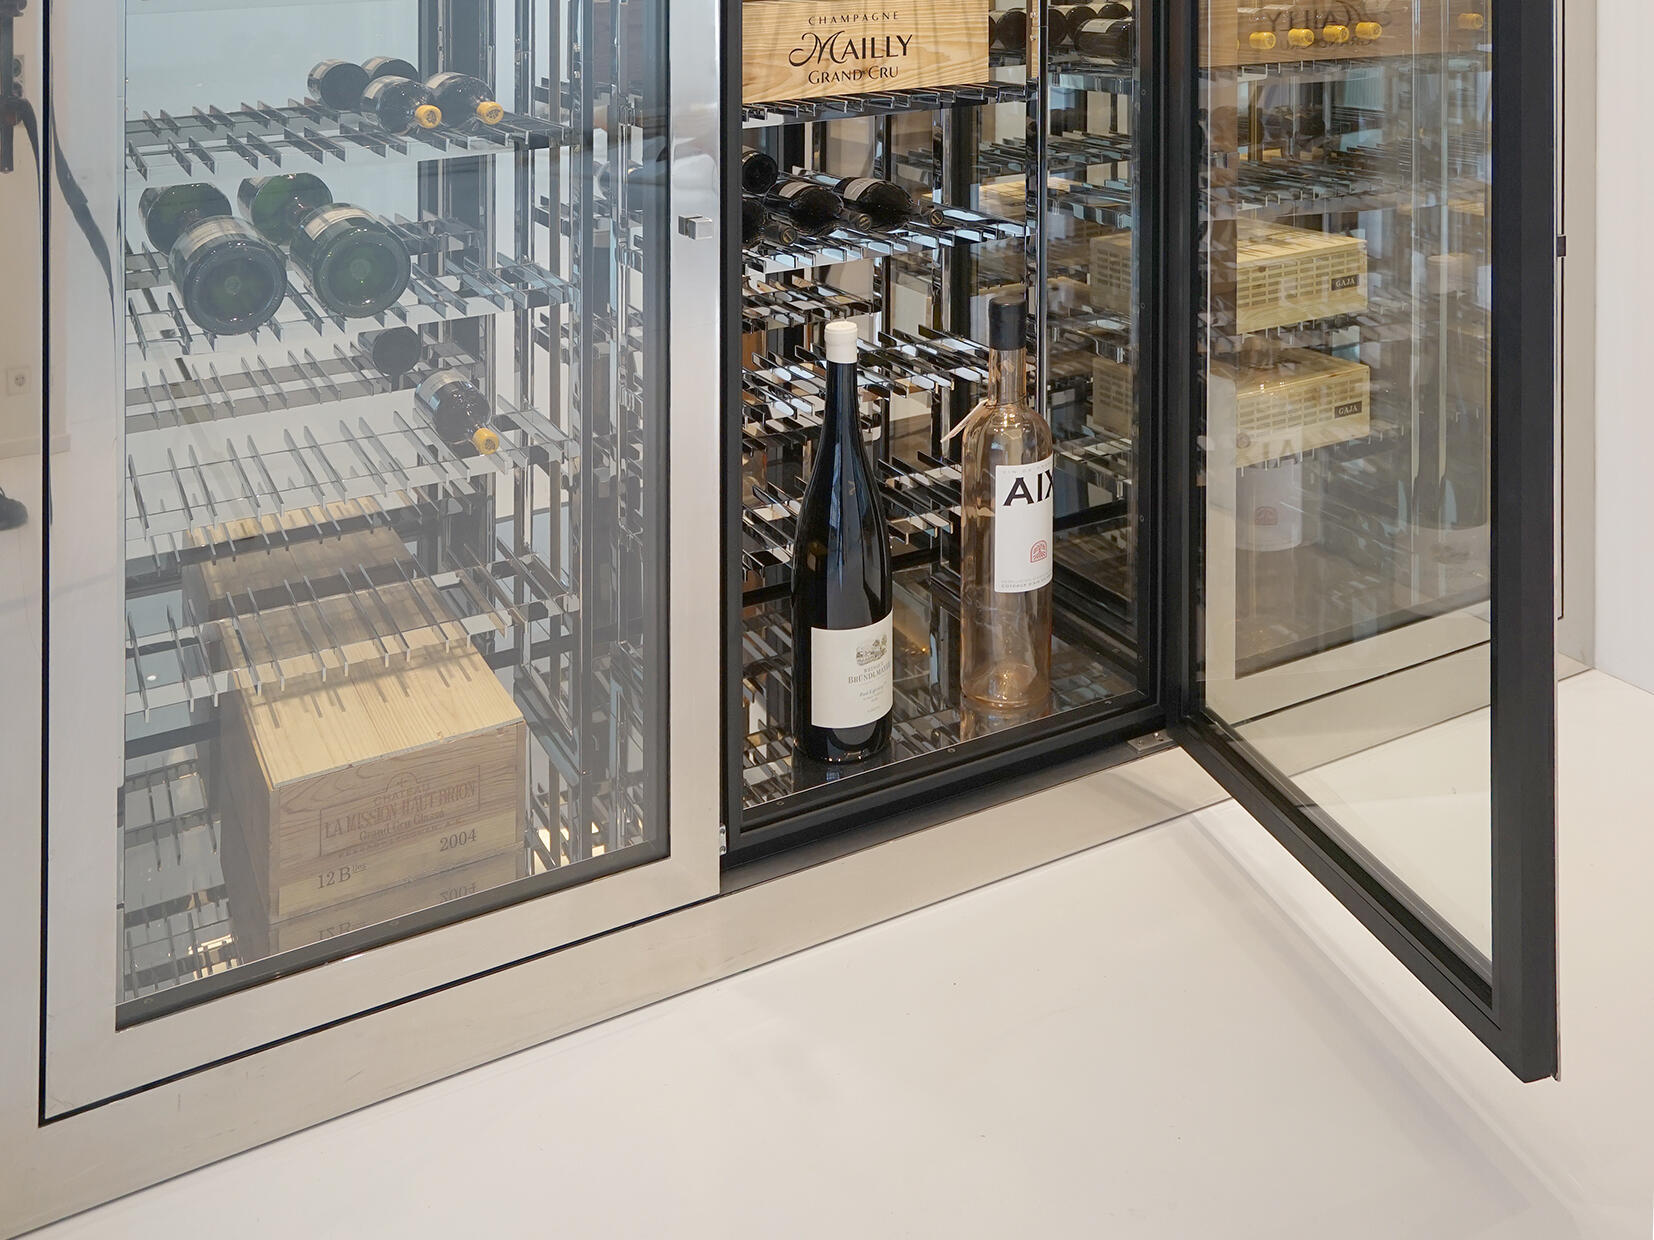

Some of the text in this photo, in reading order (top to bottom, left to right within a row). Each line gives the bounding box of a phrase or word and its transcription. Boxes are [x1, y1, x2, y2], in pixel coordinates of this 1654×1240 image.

[808, 11, 899, 26] CHAMPAGNE
[788, 30, 913, 67] MAILLY
[808, 65, 899, 85] GRAND CRU
[1335, 278, 1356, 289] GAJA
[1338, 404, 1359, 416] GAJA
[1003, 469, 1053, 506] AIX
[324, 817, 343, 839] LA
[346, 804, 397, 833] MISSION
[439, 782, 476, 806] BRION
[359, 824, 390, 842] Grand
[439, 828, 477, 853] 2004
[318, 871, 336, 889] 12
